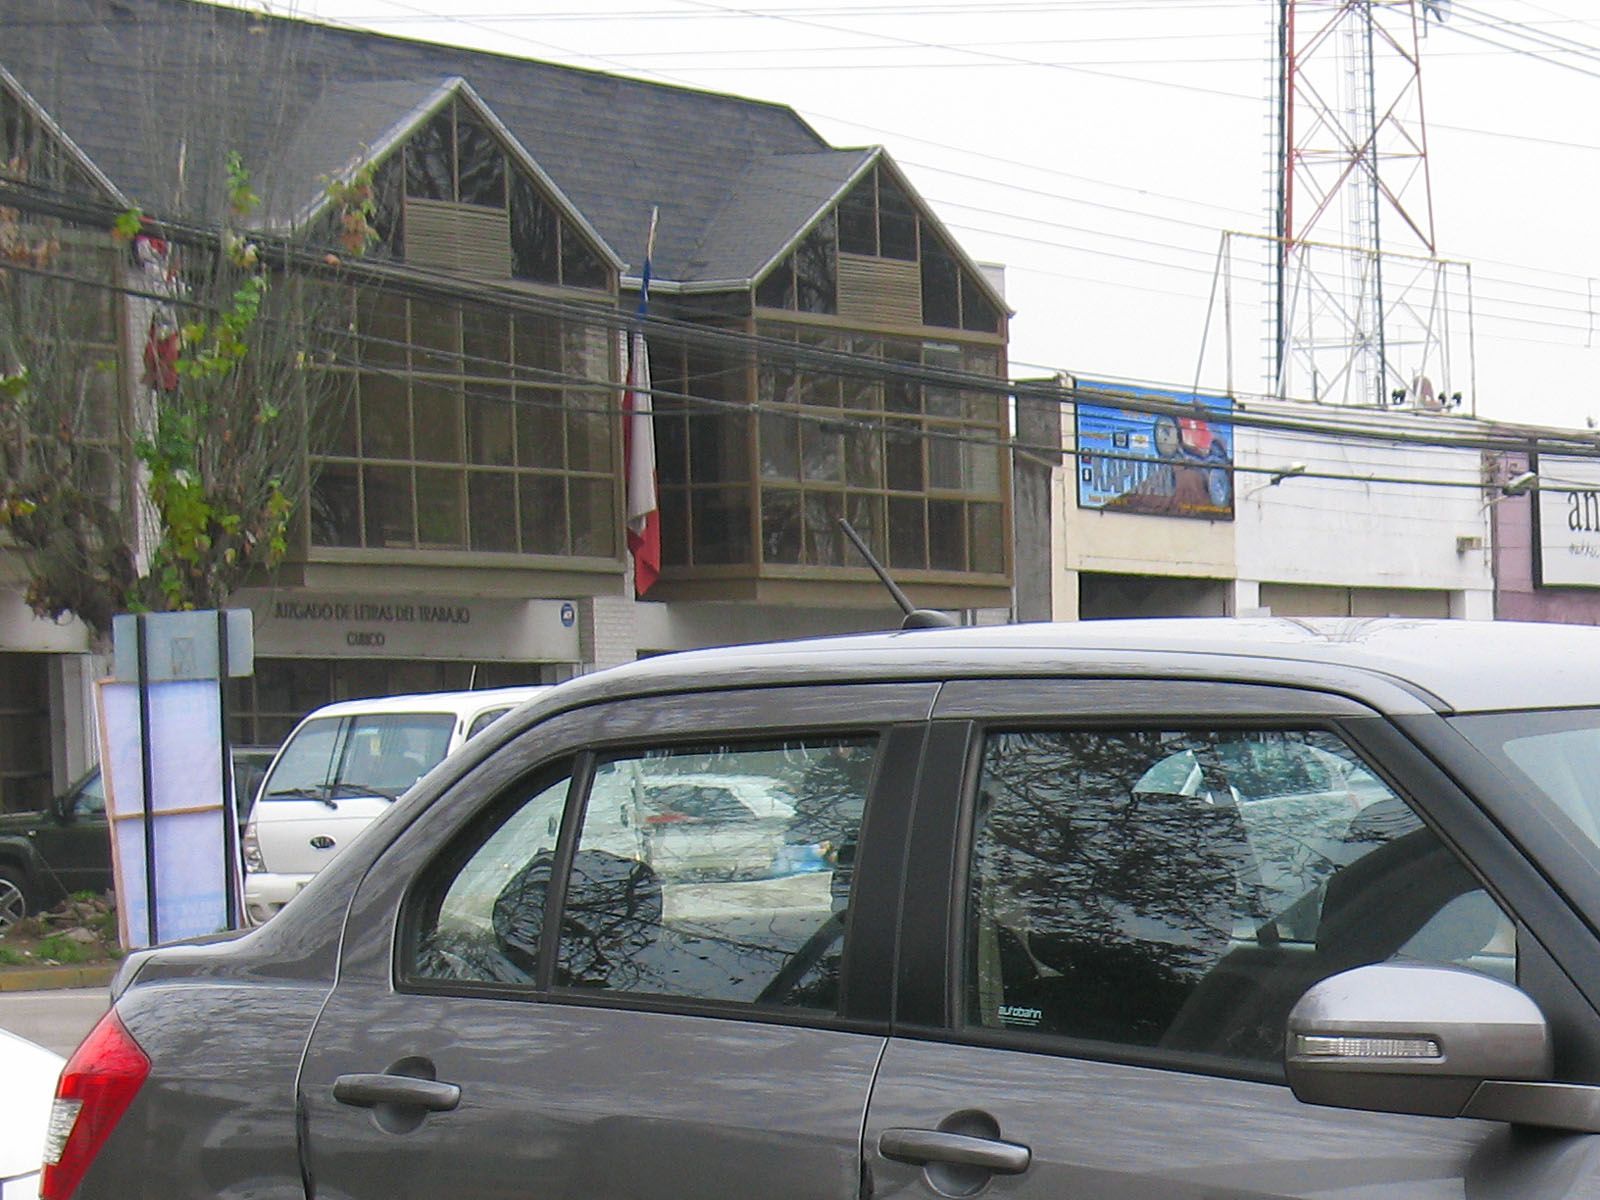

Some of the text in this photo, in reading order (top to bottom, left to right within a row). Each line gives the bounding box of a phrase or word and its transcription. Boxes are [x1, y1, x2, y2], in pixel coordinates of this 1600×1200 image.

[274, 603, 471, 624] JUZGADO DE LETRAS DEL TRABAJO
